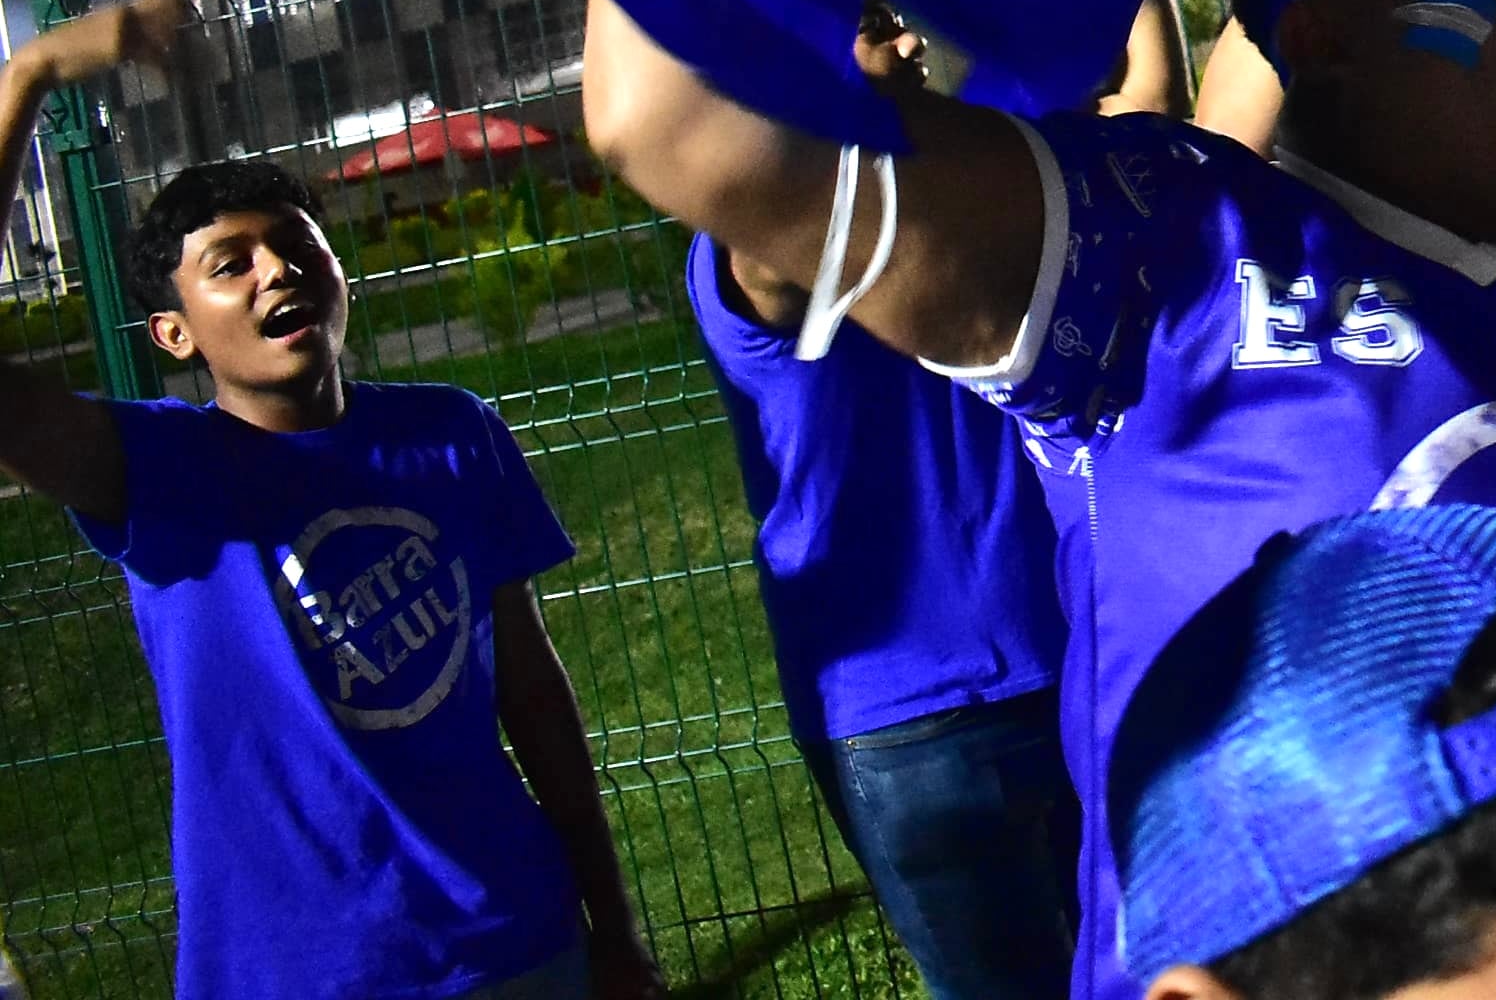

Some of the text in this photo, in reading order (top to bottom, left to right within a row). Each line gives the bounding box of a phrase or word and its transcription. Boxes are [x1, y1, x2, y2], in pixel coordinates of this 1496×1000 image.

[1231, 258, 1424, 370] ES
[300, 536, 437, 645] Barra
[333, 588, 458, 700] AZUL
